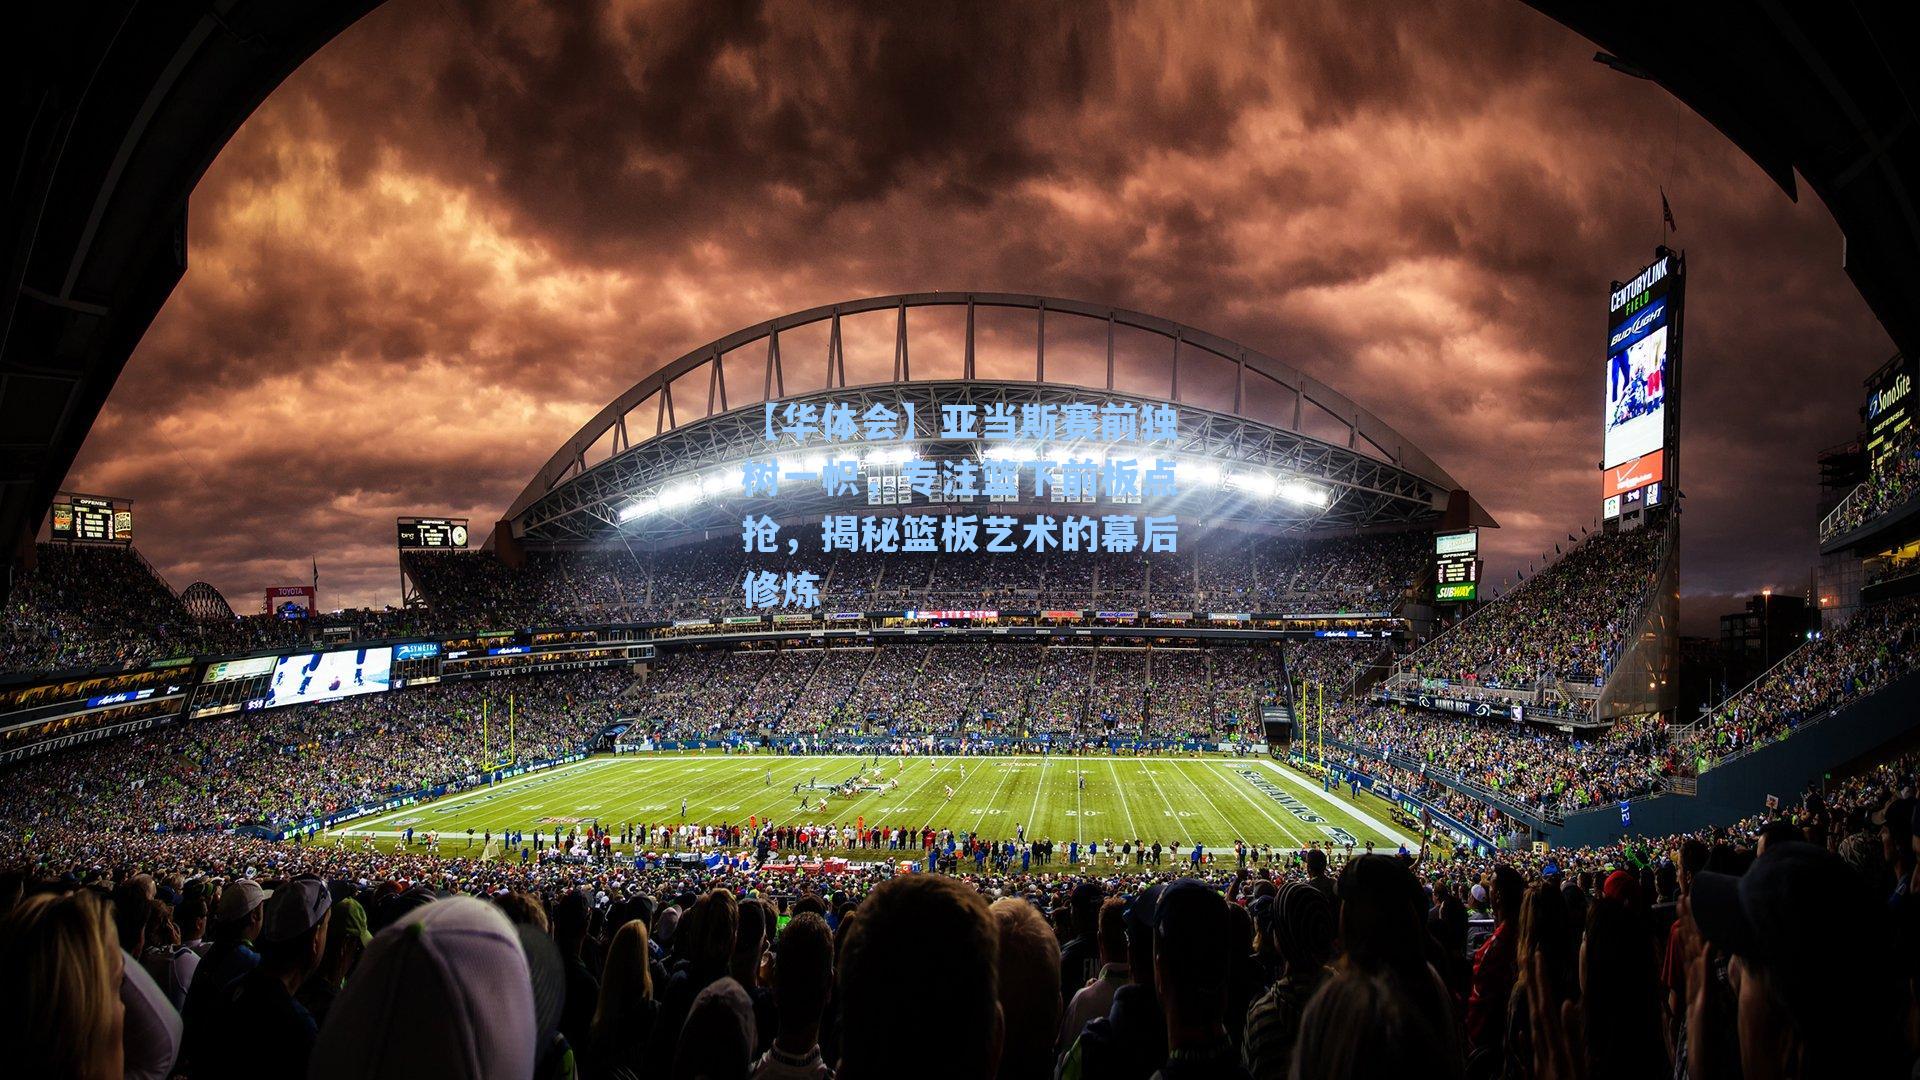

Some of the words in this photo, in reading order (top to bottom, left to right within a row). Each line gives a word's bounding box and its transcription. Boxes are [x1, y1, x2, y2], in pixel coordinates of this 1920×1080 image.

[1611, 256, 1669, 313] CENTURYLINK
[1625, 290, 1650, 316] FIELD
[1611, 327, 1633, 347] BUD
[1634, 305, 1665, 333] LIGHT
[1877, 373, 1911, 414] SonoSite
[278, 588, 303, 596] TOYOTA
[1438, 586, 1474, 599] SUBWAY
[409, 644, 438, 653] SYMETRA
[490, 667, 517, 677] HOME
[521, 666, 533, 674] OF
[538, 664, 555, 672] THE
[561, 662, 584, 671] 12TH
[589, 660, 610, 669] MAN
[1435, 698, 1455, 711] HAWKS
[1455, 700, 1471, 713] NEST
[10, 749, 24, 763] TO
[30, 730, 112, 757] CENTURYLINK
[118, 720, 153, 735] FIELD
[1234, 768, 1328, 824] SEAHAWKS
[1620, 805, 1631, 823] 12
